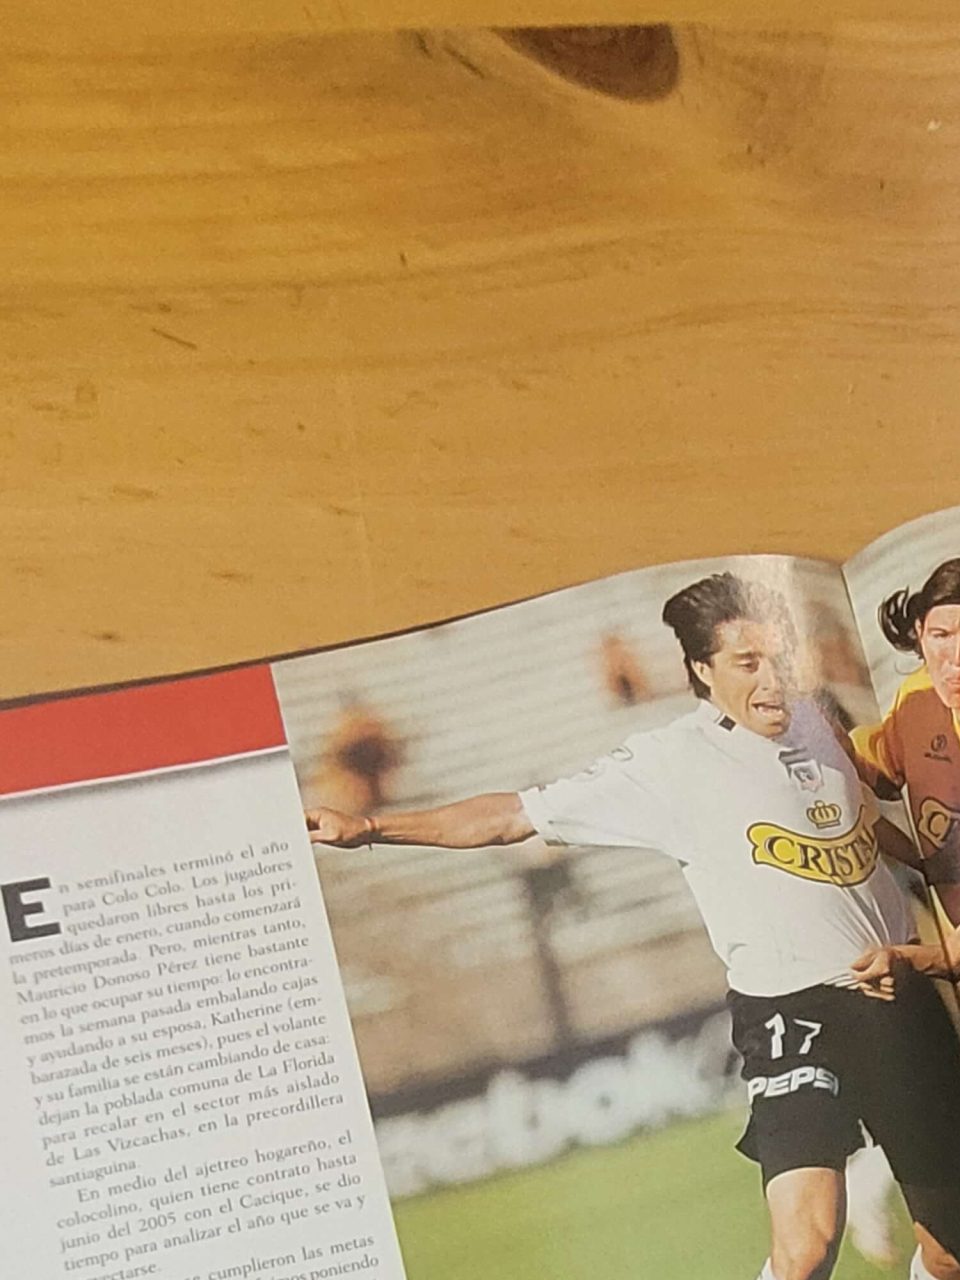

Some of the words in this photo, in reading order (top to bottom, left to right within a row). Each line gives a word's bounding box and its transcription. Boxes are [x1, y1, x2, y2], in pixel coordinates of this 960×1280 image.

[57, 884, 70, 894] n
[76, 865, 166, 890] semifinales
[172, 850, 234, 873] terminó
[240, 844, 255, 859] el
[261, 841, 289, 855] año
[62, 899, 96, 918] para
[100, 889, 139, 906] Colo
[143, 880, 185, 898] Colo.
[190, 875, 219, 889] Los
[224, 861, 293, 886] jugadores
[0, 878, 61, 942] E
[764, 1012, 823, 1060] 17
